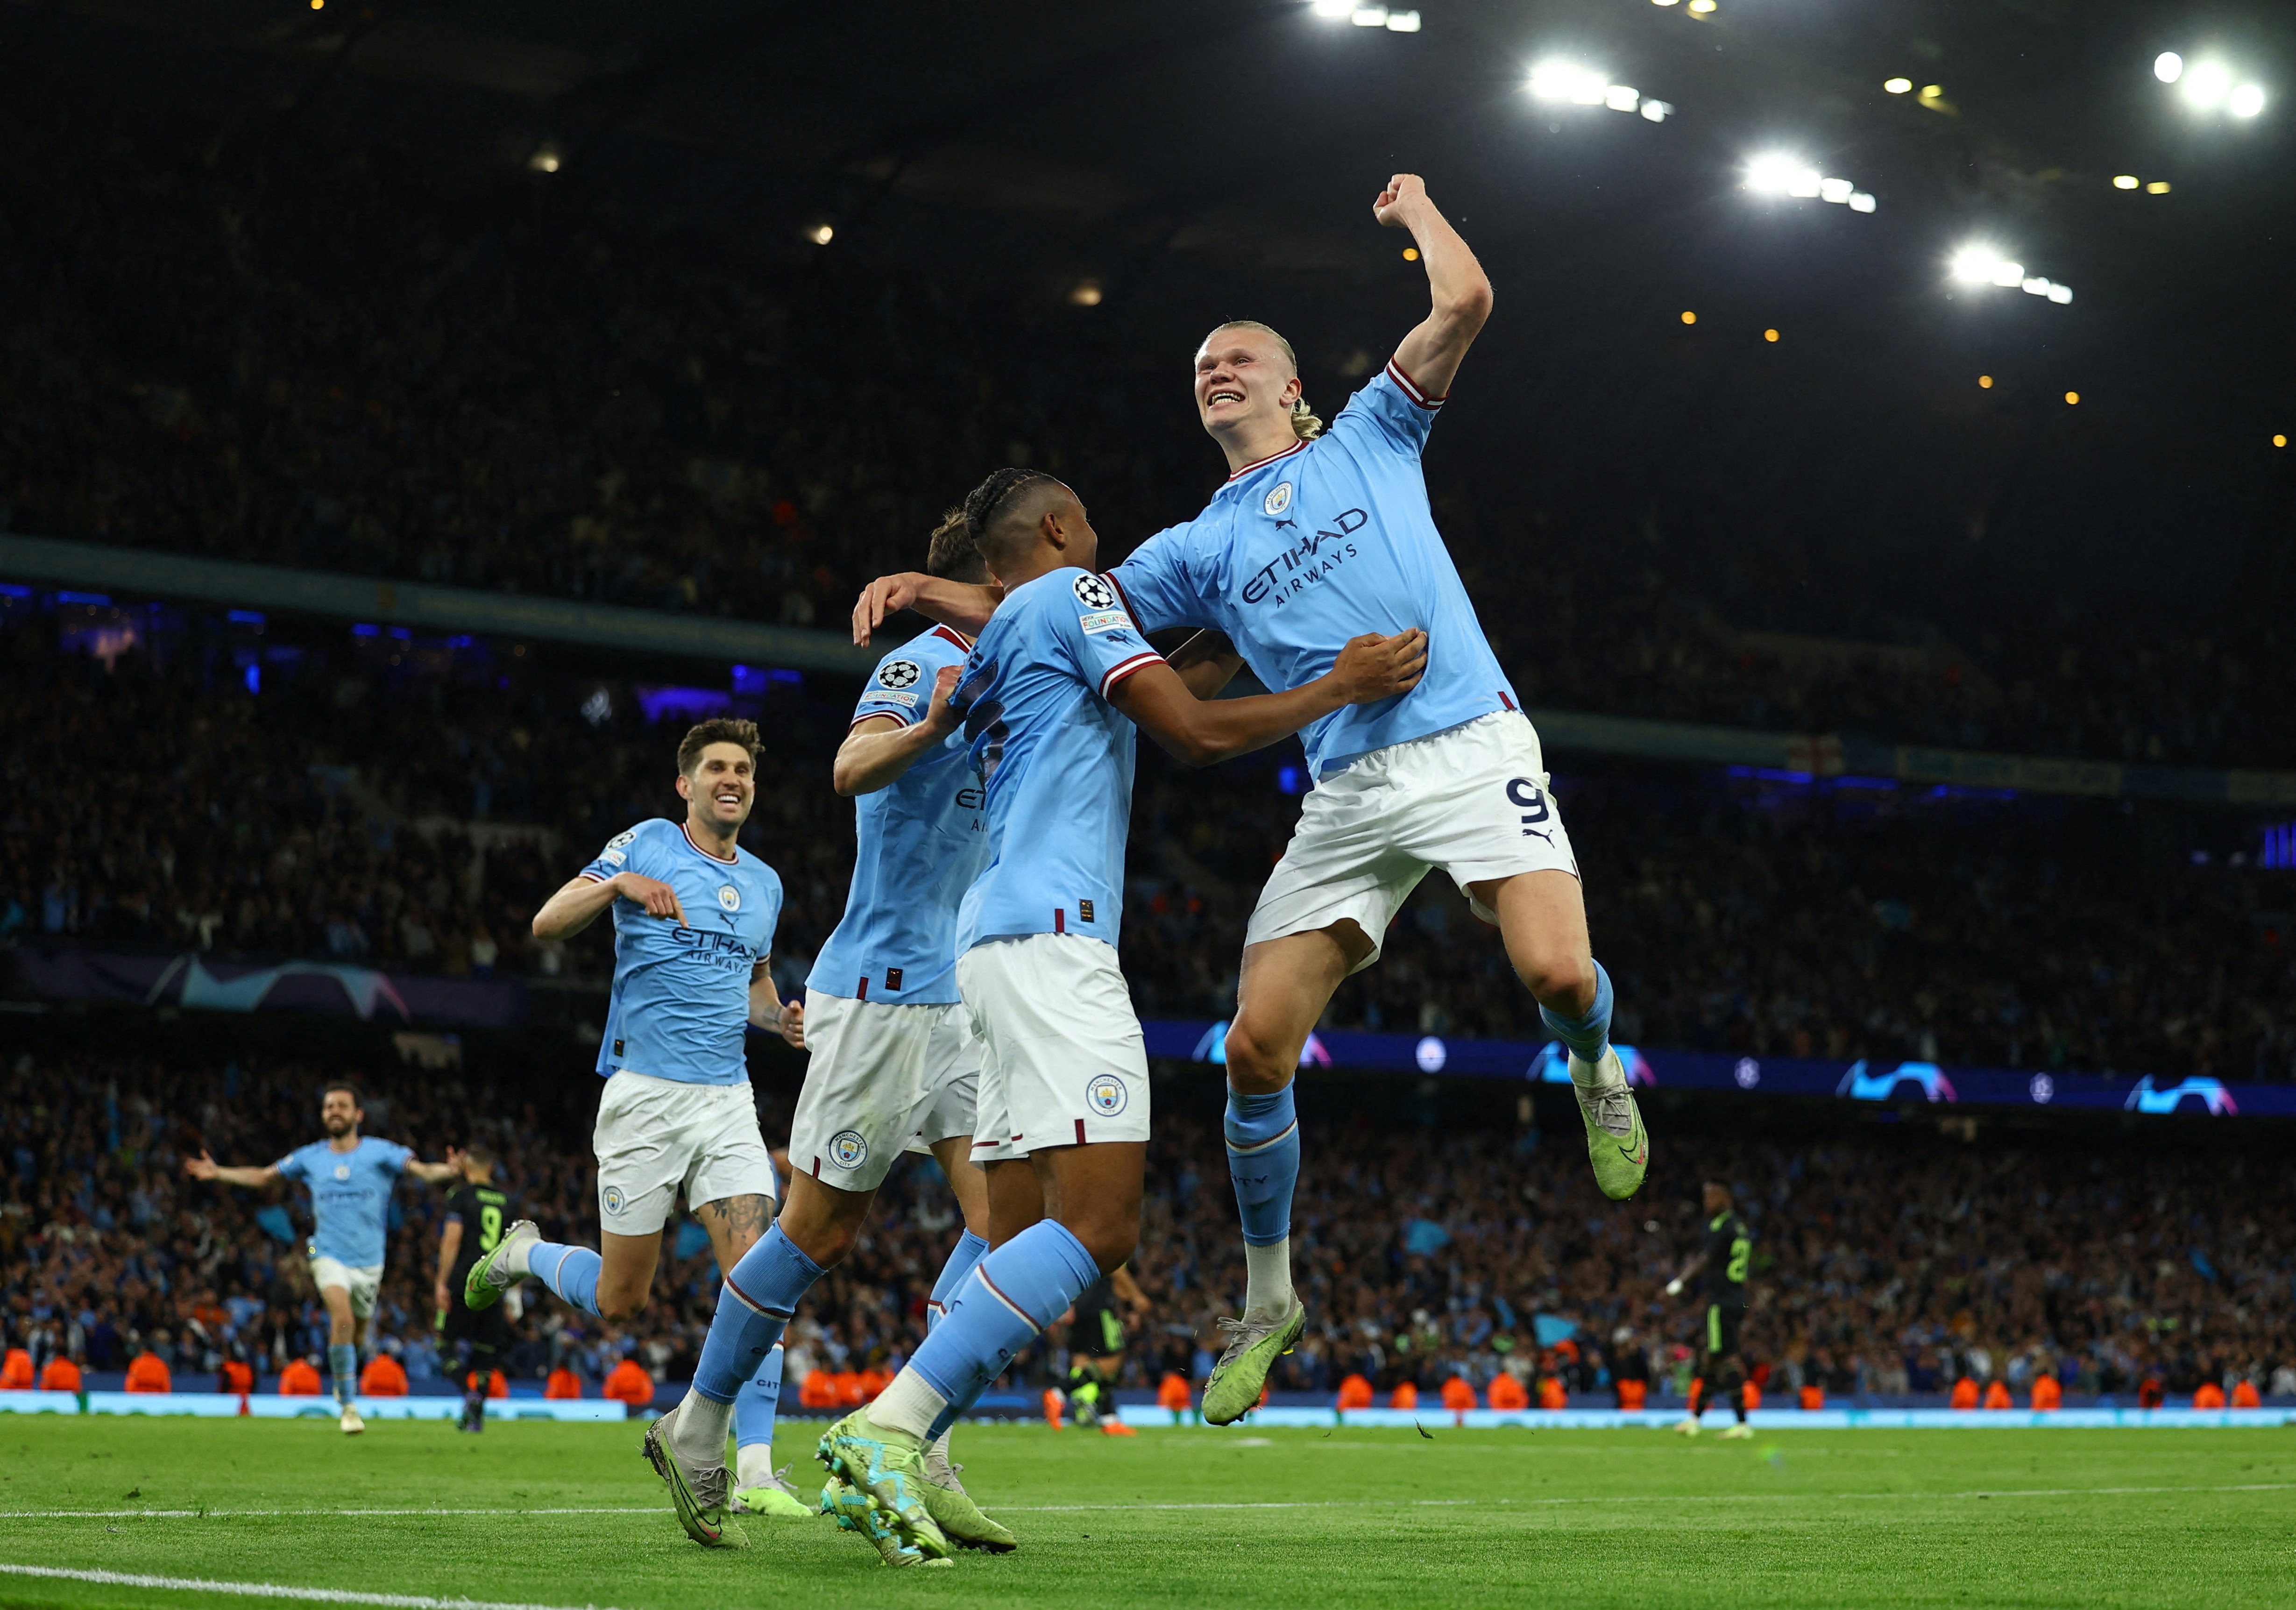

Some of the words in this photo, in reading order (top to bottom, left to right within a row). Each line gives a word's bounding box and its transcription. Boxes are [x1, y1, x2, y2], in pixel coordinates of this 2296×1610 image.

[1267, 484, 1290, 504] MANCHESTER
[1242, 508, 1368, 604] ETIHAD
[1276, 543, 1357, 609] AIRWAYS
[1083, 616, 1129, 628] FOUNDATION
[865, 694, 916, 702] FOUNDATION
[1506, 779, 1549, 824] 9
[1090, 1078, 1122, 1091] MANCHESTER
[835, 1133, 865, 1149] MANCHESTER
[479, 1204, 503, 1253] 9
[757, 1379, 781, 1389] CIT
